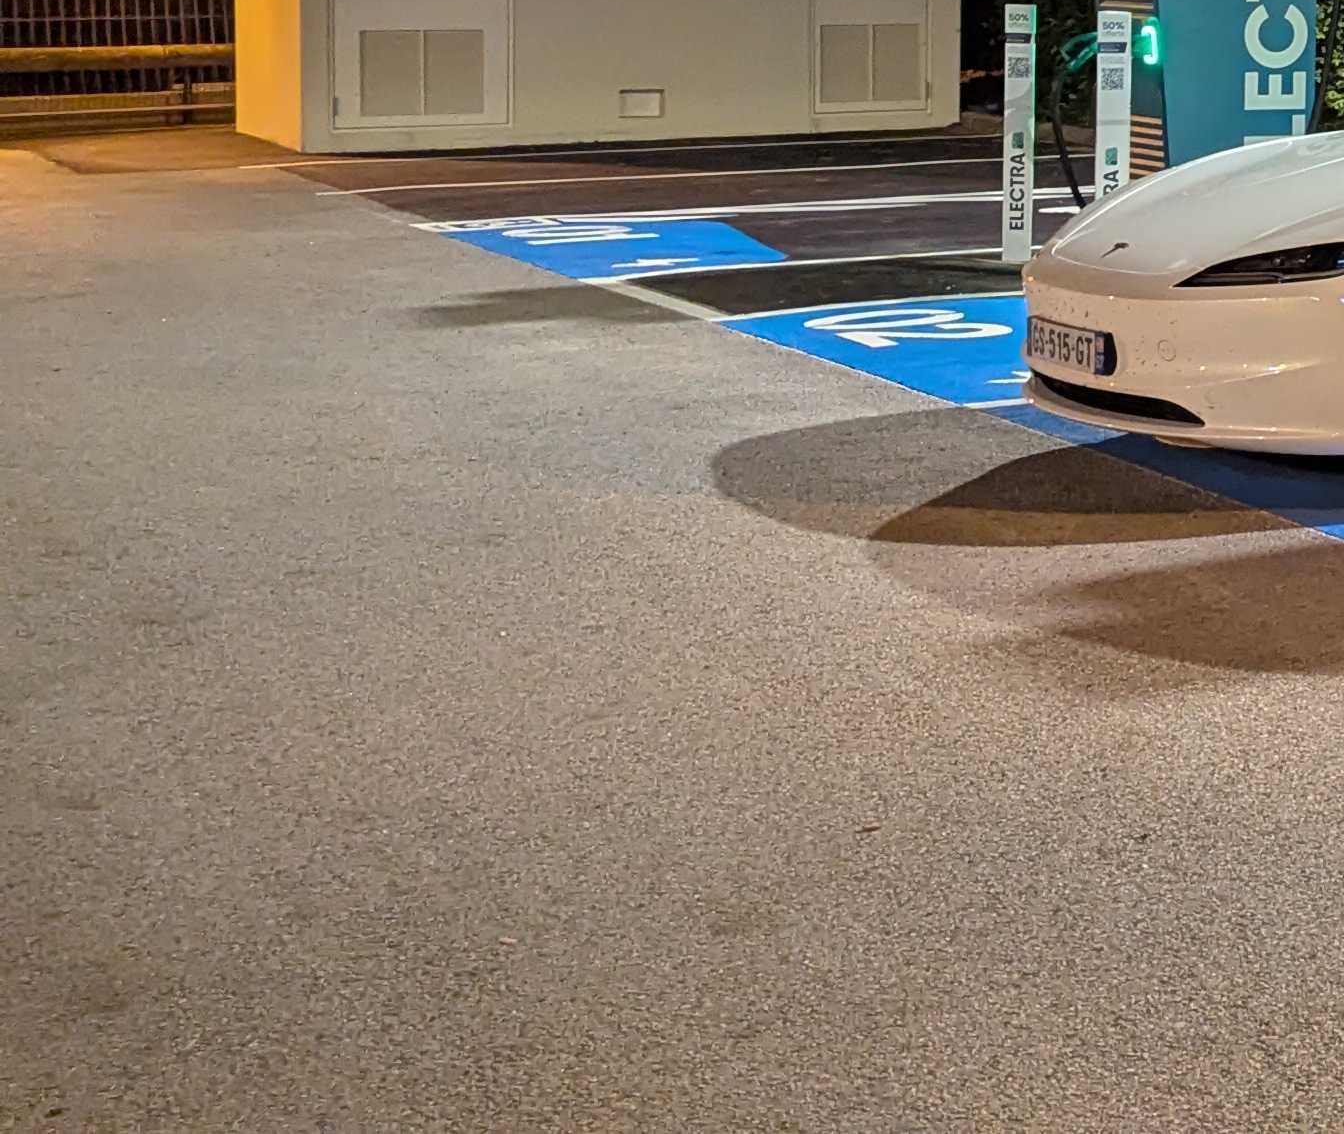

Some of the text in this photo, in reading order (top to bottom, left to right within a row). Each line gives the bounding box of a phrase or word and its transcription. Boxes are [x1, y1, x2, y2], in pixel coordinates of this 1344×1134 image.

[1102, 21, 1125, 31] 50%
[1009, 152, 1026, 231] ELECTRA
[803, 308, 1014, 348] 02
